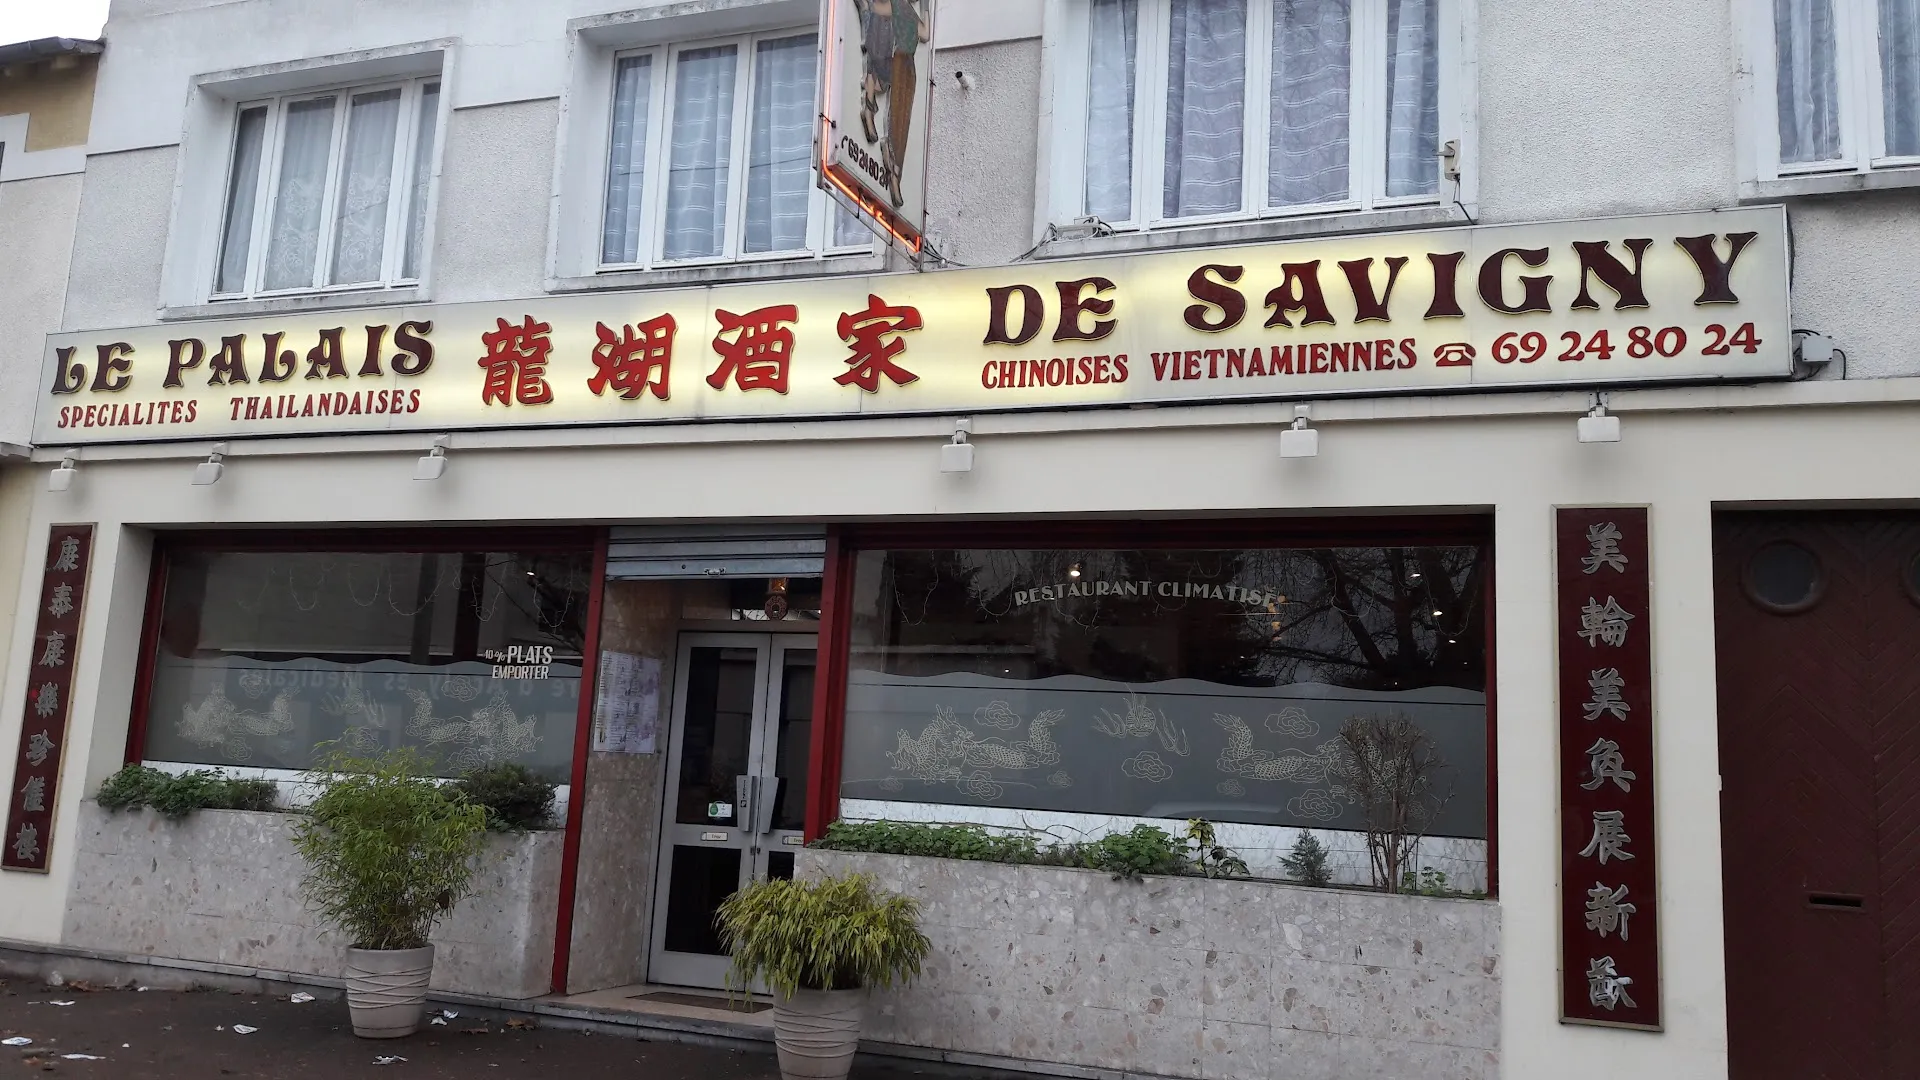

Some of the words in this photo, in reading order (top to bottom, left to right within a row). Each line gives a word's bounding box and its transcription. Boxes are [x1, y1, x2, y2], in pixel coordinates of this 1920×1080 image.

[848, 138, 859, 162] 69
[859, 148, 868, 173] 24
[869, 157, 879, 181] 80
[982, 276, 1118, 347] DE
[1183, 231, 1759, 334] SAVIGNY
[50, 342, 135, 395] LE
[163, 319, 435, 389] PALAIS
[477, 293, 925, 407] 龍湖酒家
[981, 354, 1129, 389] CHINOISES
[1150, 337, 1417, 382] VIETNAMIENNES
[1491, 331, 1548, 364] 69
[1558, 329, 1616, 362] 24
[1627, 326, 1688, 359] 80
[1701, 322, 1762, 356] 24
[57, 400, 198, 429] SPECIALITES
[230, 389, 421, 422] THAILANDAISES
[1014, 581, 1152, 606] RESTAURANT
[492, 665, 549, 680] EMPORTER
[507, 645, 554, 665] PLATS
